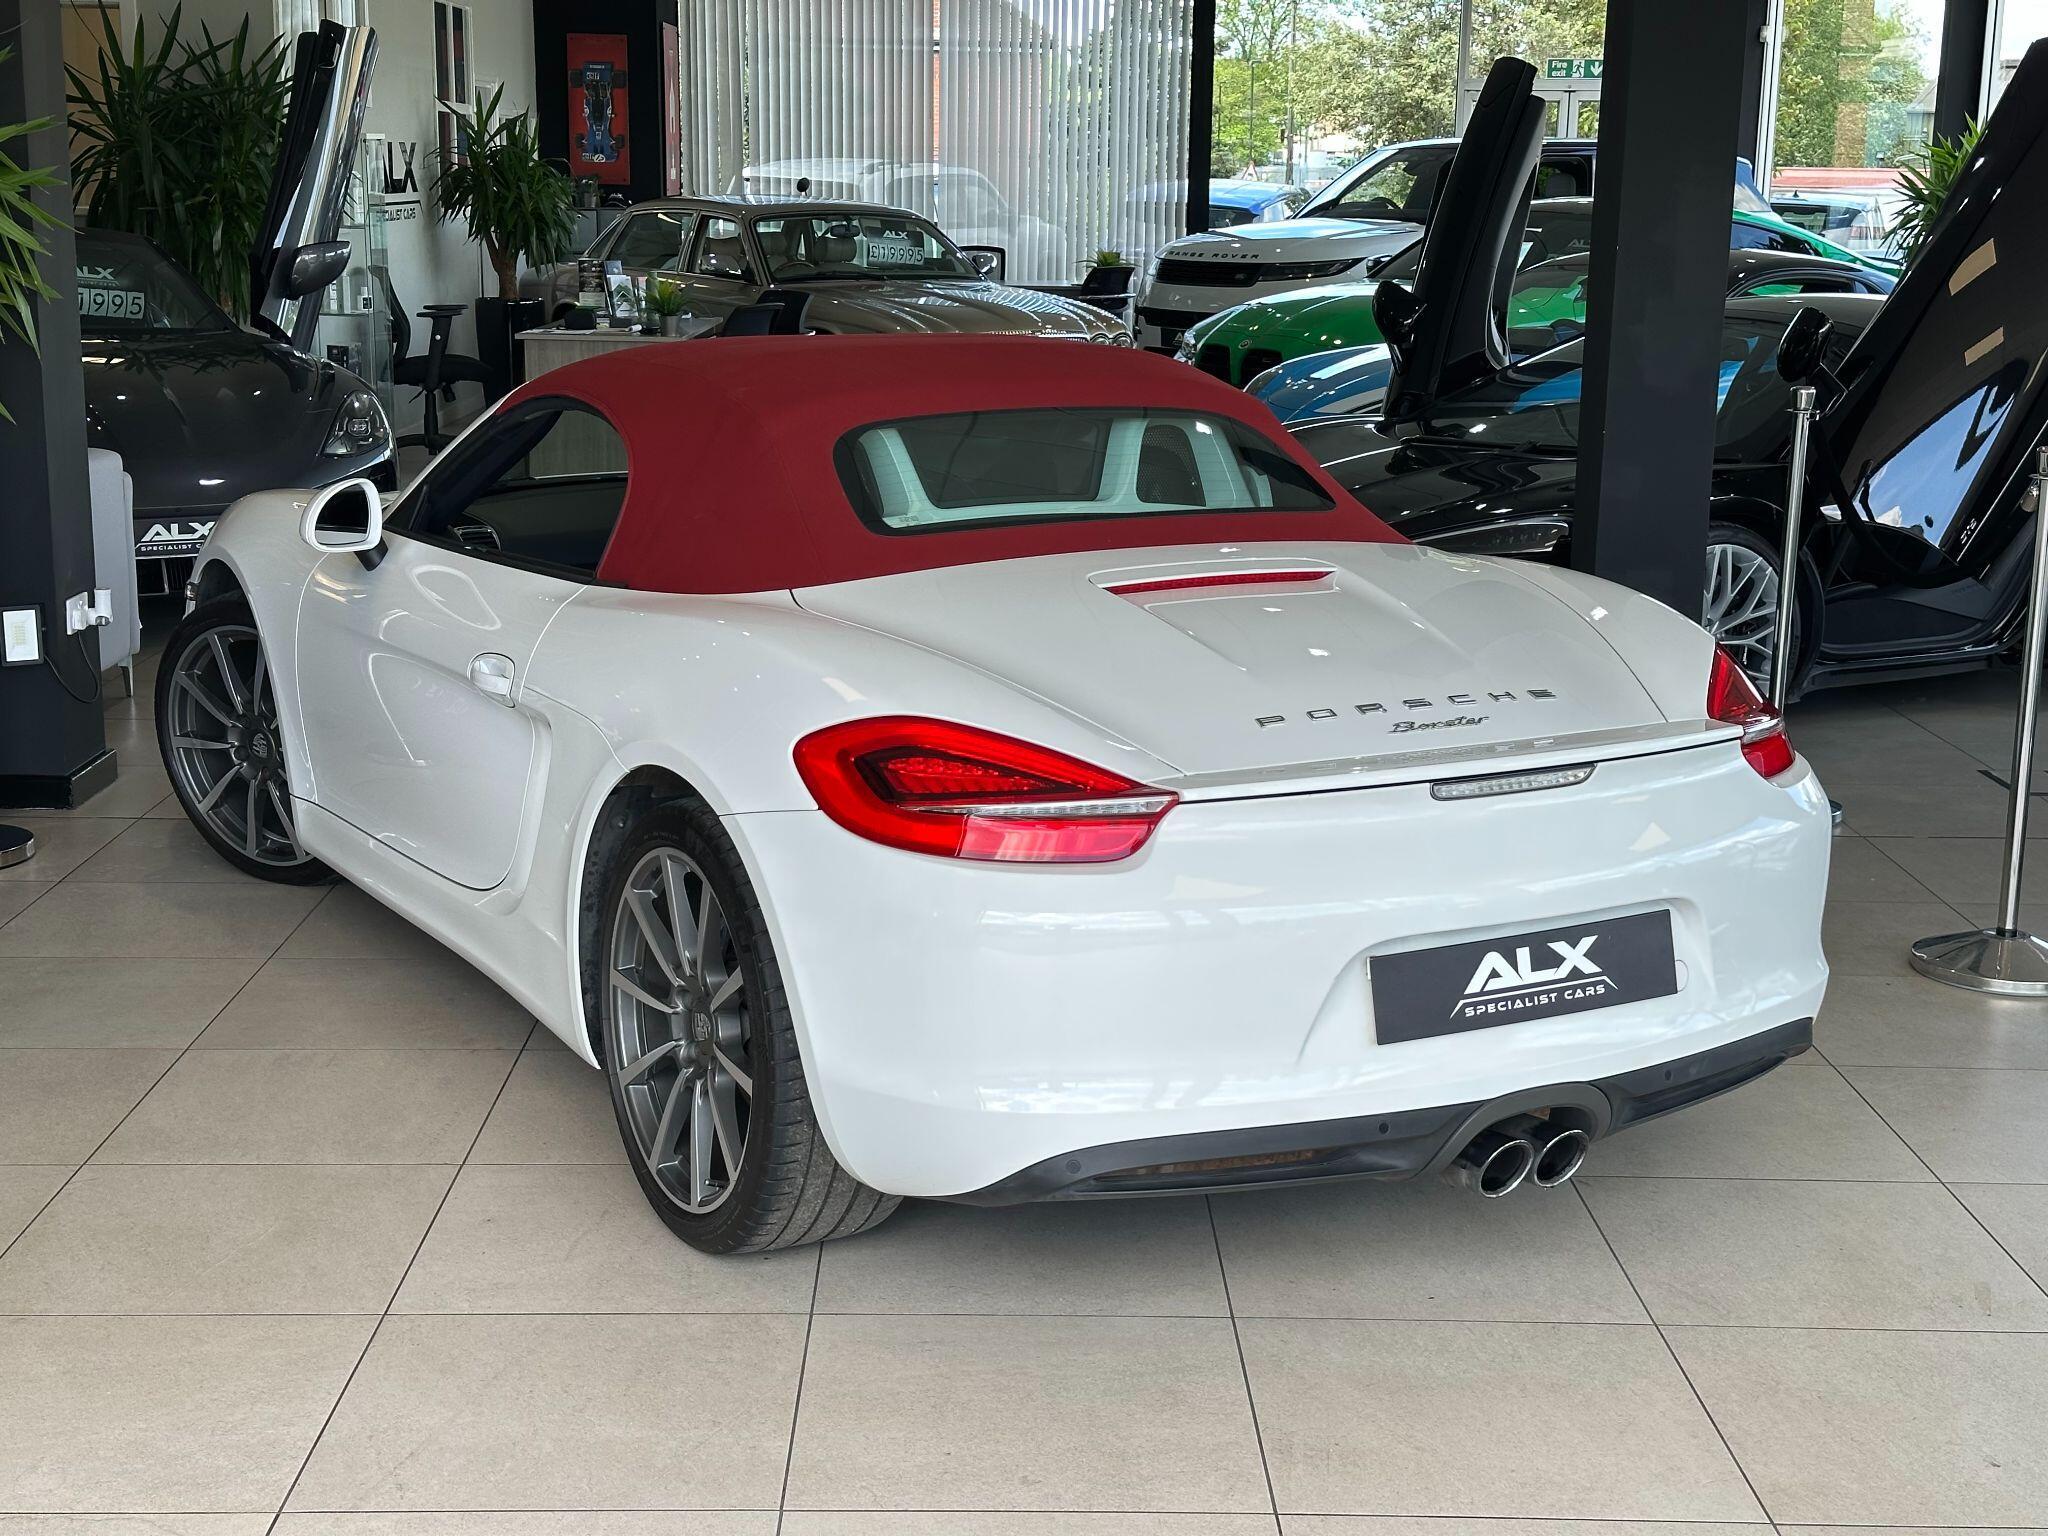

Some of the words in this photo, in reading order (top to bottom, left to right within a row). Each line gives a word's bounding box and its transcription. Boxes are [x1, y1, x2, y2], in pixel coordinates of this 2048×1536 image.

[1552, 69, 1566, 77] exit
[883, 230, 909, 240] ALX
[1568, 239, 1590, 248] AL
[870, 245, 924, 262] £19995
[1166, 250, 1205, 258] RANGE
[141, 521, 216, 542] ALX
[141, 543, 192, 552] SPECIALIST
[1254, 689, 1558, 729] PORSCHE
[1387, 714, 1490, 734] Boxster
[1463, 934, 1603, 995] ALX
[1464, 992, 1558, 1018] SPECIALIST
[1564, 984, 1606, 1000] CARS
